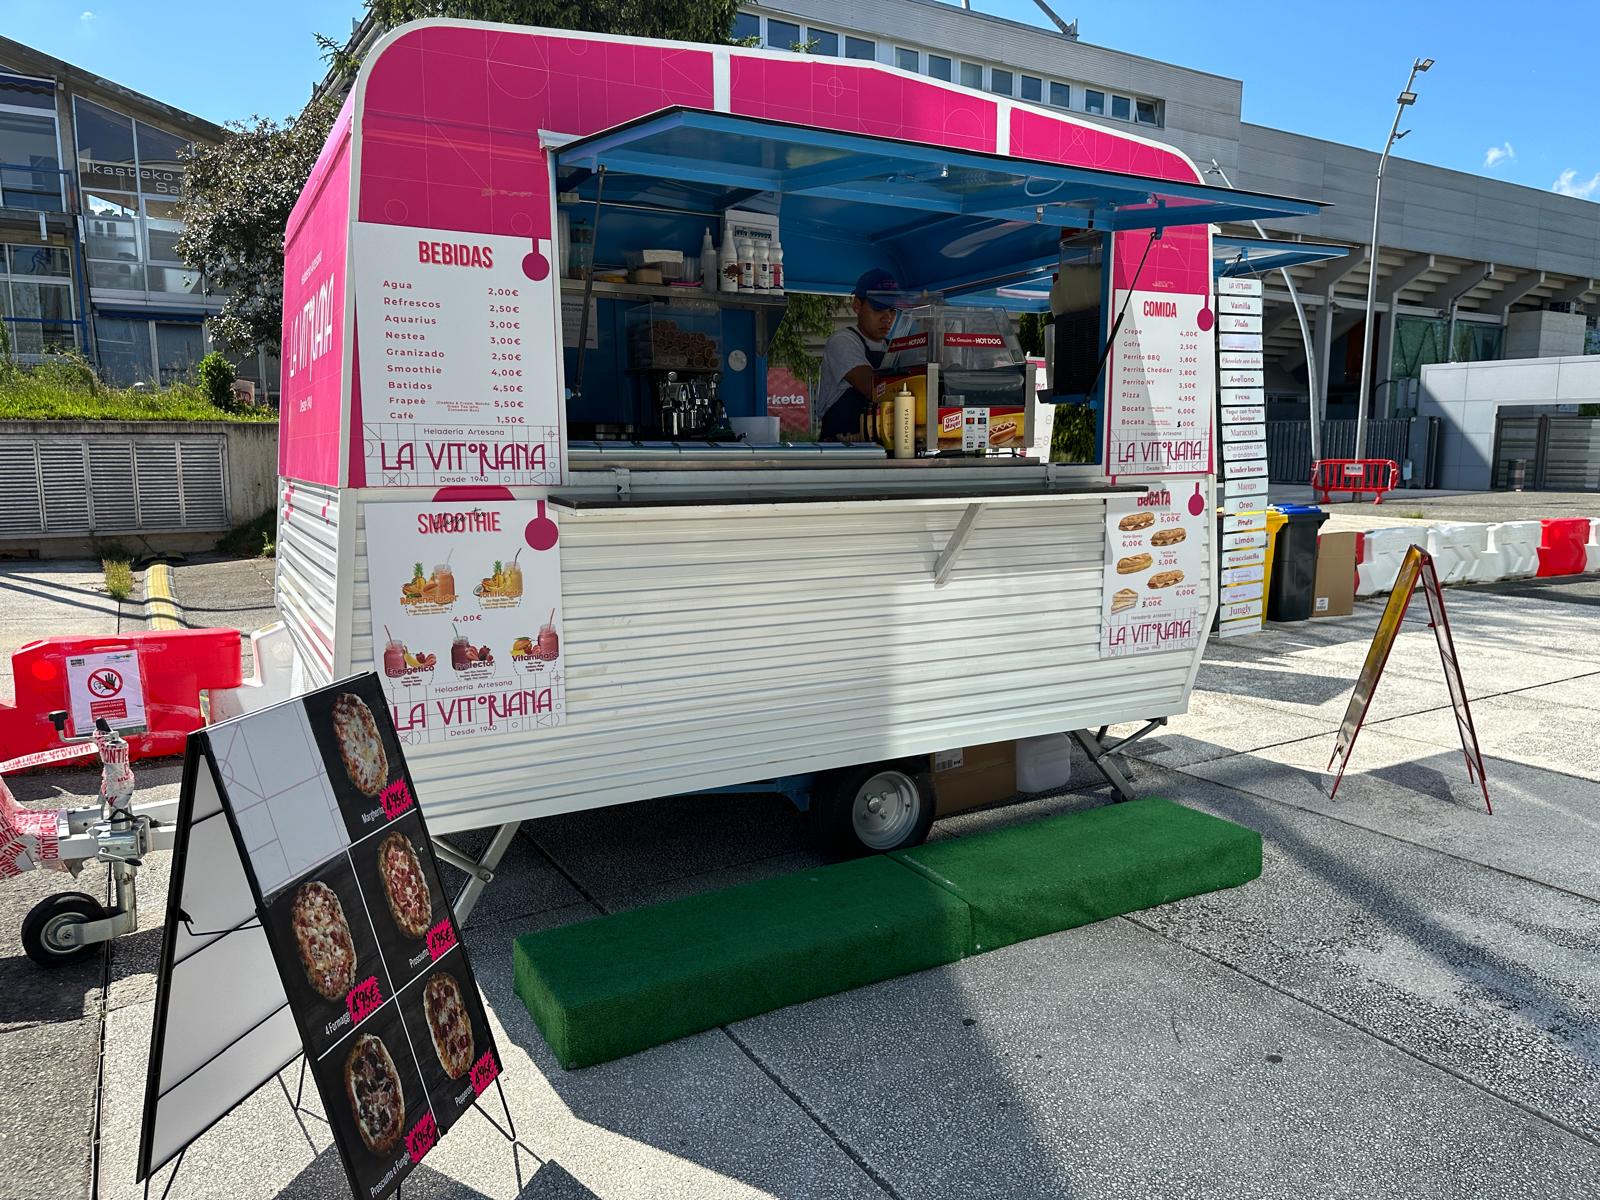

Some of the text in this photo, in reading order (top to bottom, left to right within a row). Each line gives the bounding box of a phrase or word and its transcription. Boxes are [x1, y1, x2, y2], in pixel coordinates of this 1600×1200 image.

[418, 240, 494, 269] BEBIDAS
[382, 279, 413, 290] Agua
[488, 287, 519, 297] 2,00€
[383, 297, 441, 309] Refrescos
[1230, 301, 1251, 310] Vainilla
[489, 304, 520, 314] 2,50€
[1143, 300, 1177, 318] COMIDA
[384, 314, 437, 325] Aquarius
[489, 320, 521, 330] 3,00€
[385, 331, 426, 341] Nestea
[490, 336, 521, 346] 3,00€
[386, 348, 445, 358] Granizado
[491, 352, 522, 362] 2,50€
[387, 364, 442, 374] Smoothie
[491, 368, 523, 378] 4,00€
[388, 381, 433, 390] Batidos
[492, 384, 524, 393] 4,50€
[494, 400, 525, 409] 5,50€
[496, 415, 526, 424] 1,50€
[944, 414, 961, 424] Oscar
[944, 421, 961, 431] Mayer
[423, 427, 505, 437] Heladería Artesana
[381, 442, 415, 471] LA
[1118, 442, 1135, 463] LA
[439, 474, 489, 484] Desde 1940
[1238, 501, 1254, 509] Oreo
[417, 511, 502, 535] SMOOTHIE
[1234, 536, 1255, 545] Limón
[1229, 604, 1251, 617] Jungly
[453, 615, 483, 623] 4,00€
[1108, 626, 1126, 646] LA
[434, 679, 513, 694] Heladería Artesana
[394, 702, 426, 731] LA
[450, 725, 498, 738] Desde 1940
[369, 1168, 395, 1198] Prosciutto
